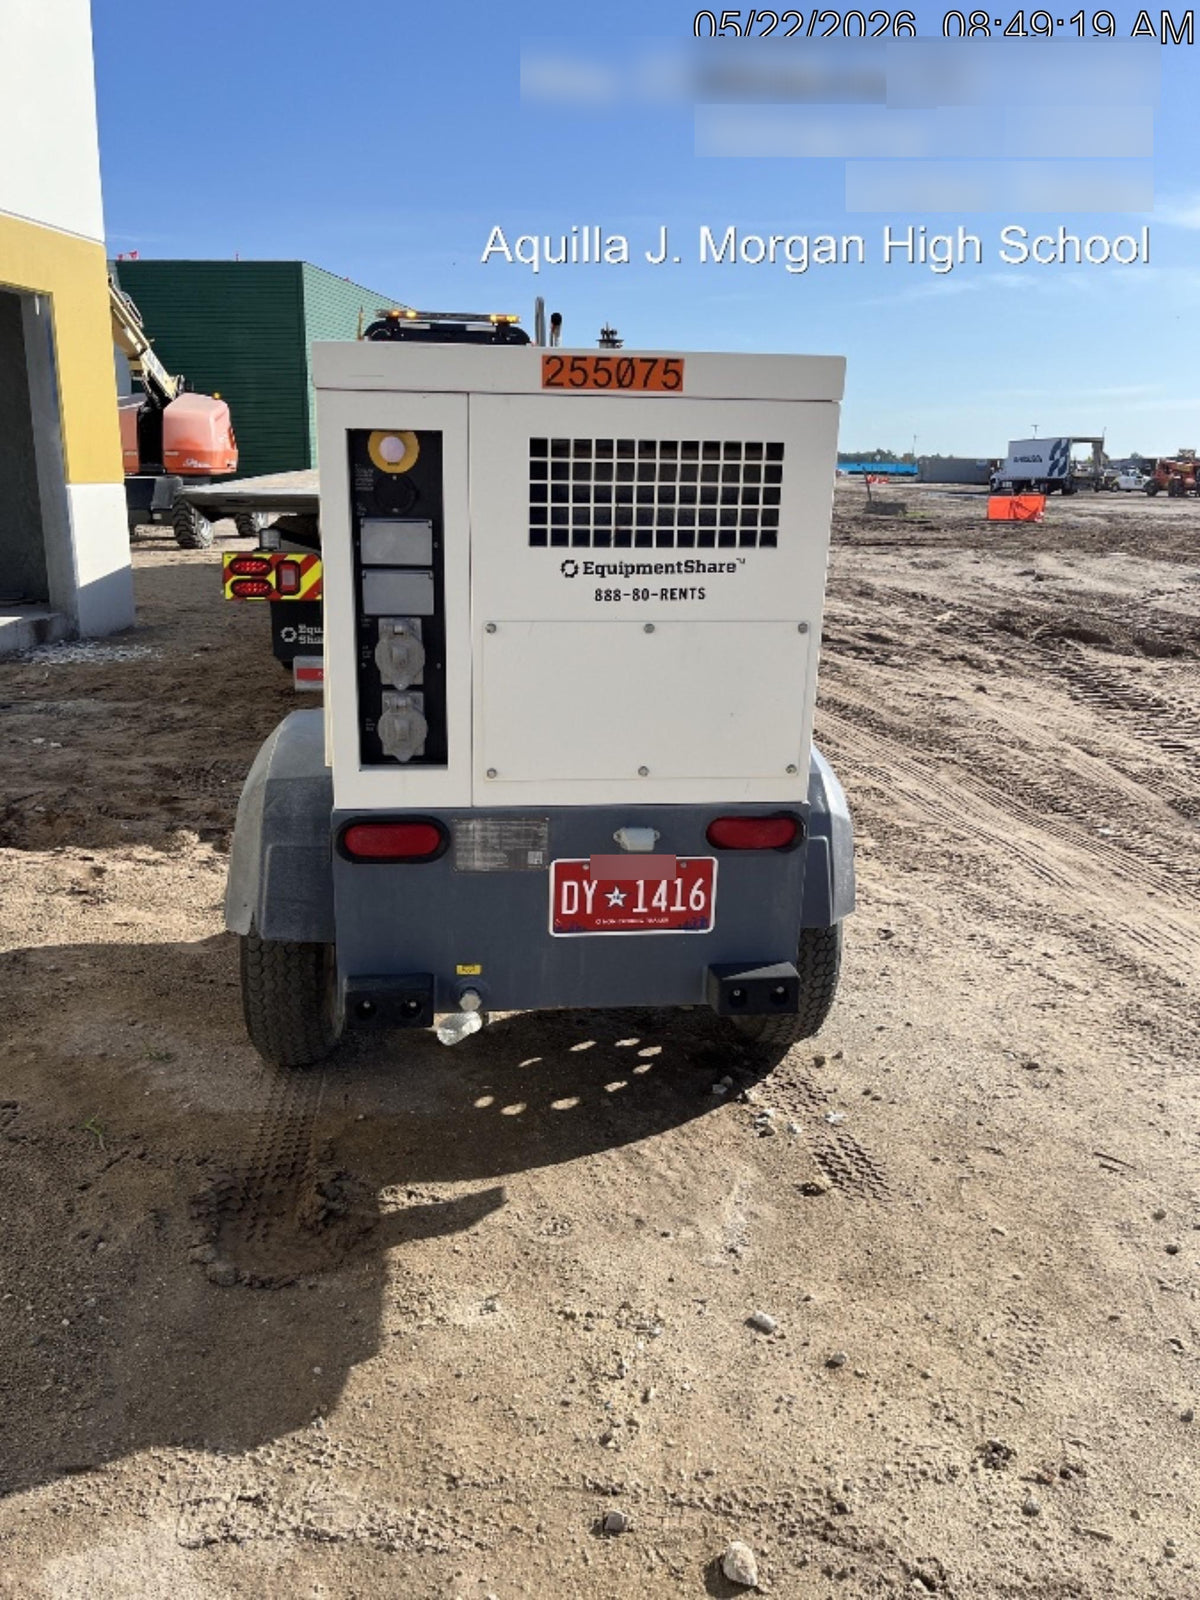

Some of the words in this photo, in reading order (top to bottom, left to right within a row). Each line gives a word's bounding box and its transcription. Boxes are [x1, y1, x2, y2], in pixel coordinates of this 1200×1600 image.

[544, 355, 683, 391] 255075
[582, 560, 737, 578] EquipmentShare
[594, 587, 706, 602] 888-80-RENTS
[561, 880, 598, 915] DY
[631, 877, 706, 914] 1416
